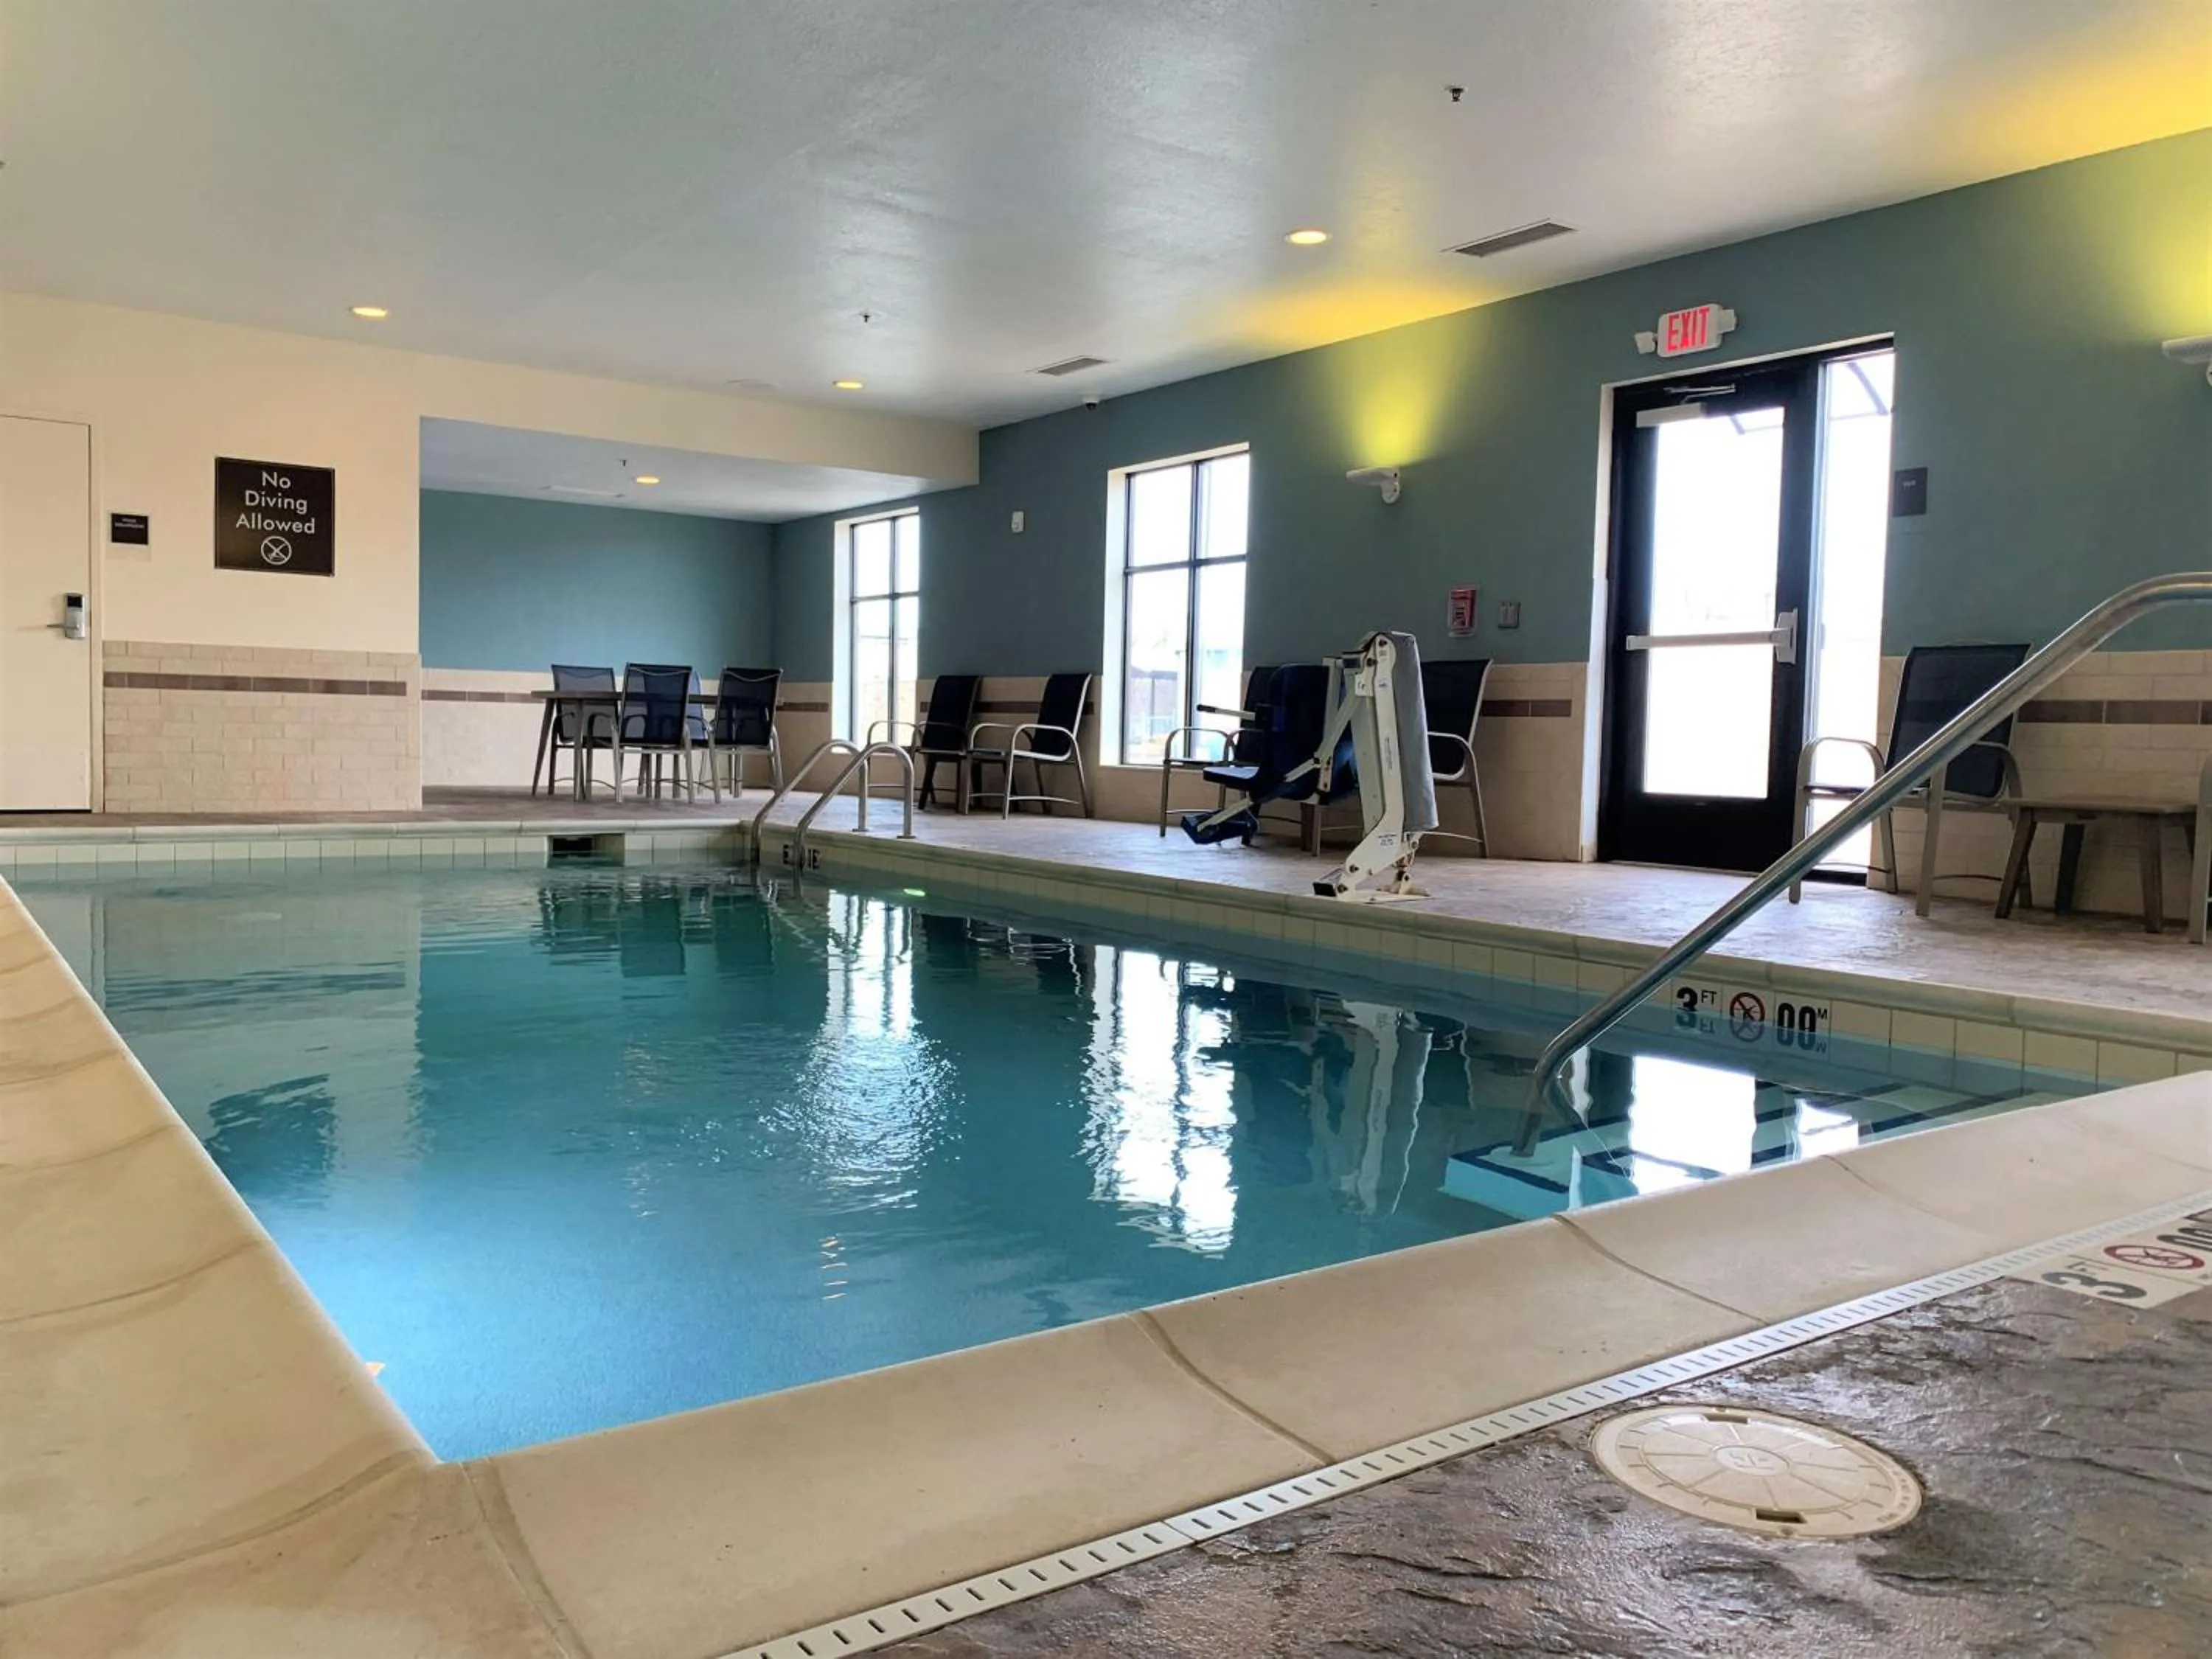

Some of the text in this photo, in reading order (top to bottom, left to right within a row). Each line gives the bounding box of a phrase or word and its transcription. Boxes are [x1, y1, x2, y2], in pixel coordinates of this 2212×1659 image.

[1666, 307, 1709, 352] EXIT
[262, 472, 291, 488] No
[246, 490, 307, 514] Diving
[235, 513, 316, 534] Allowed
